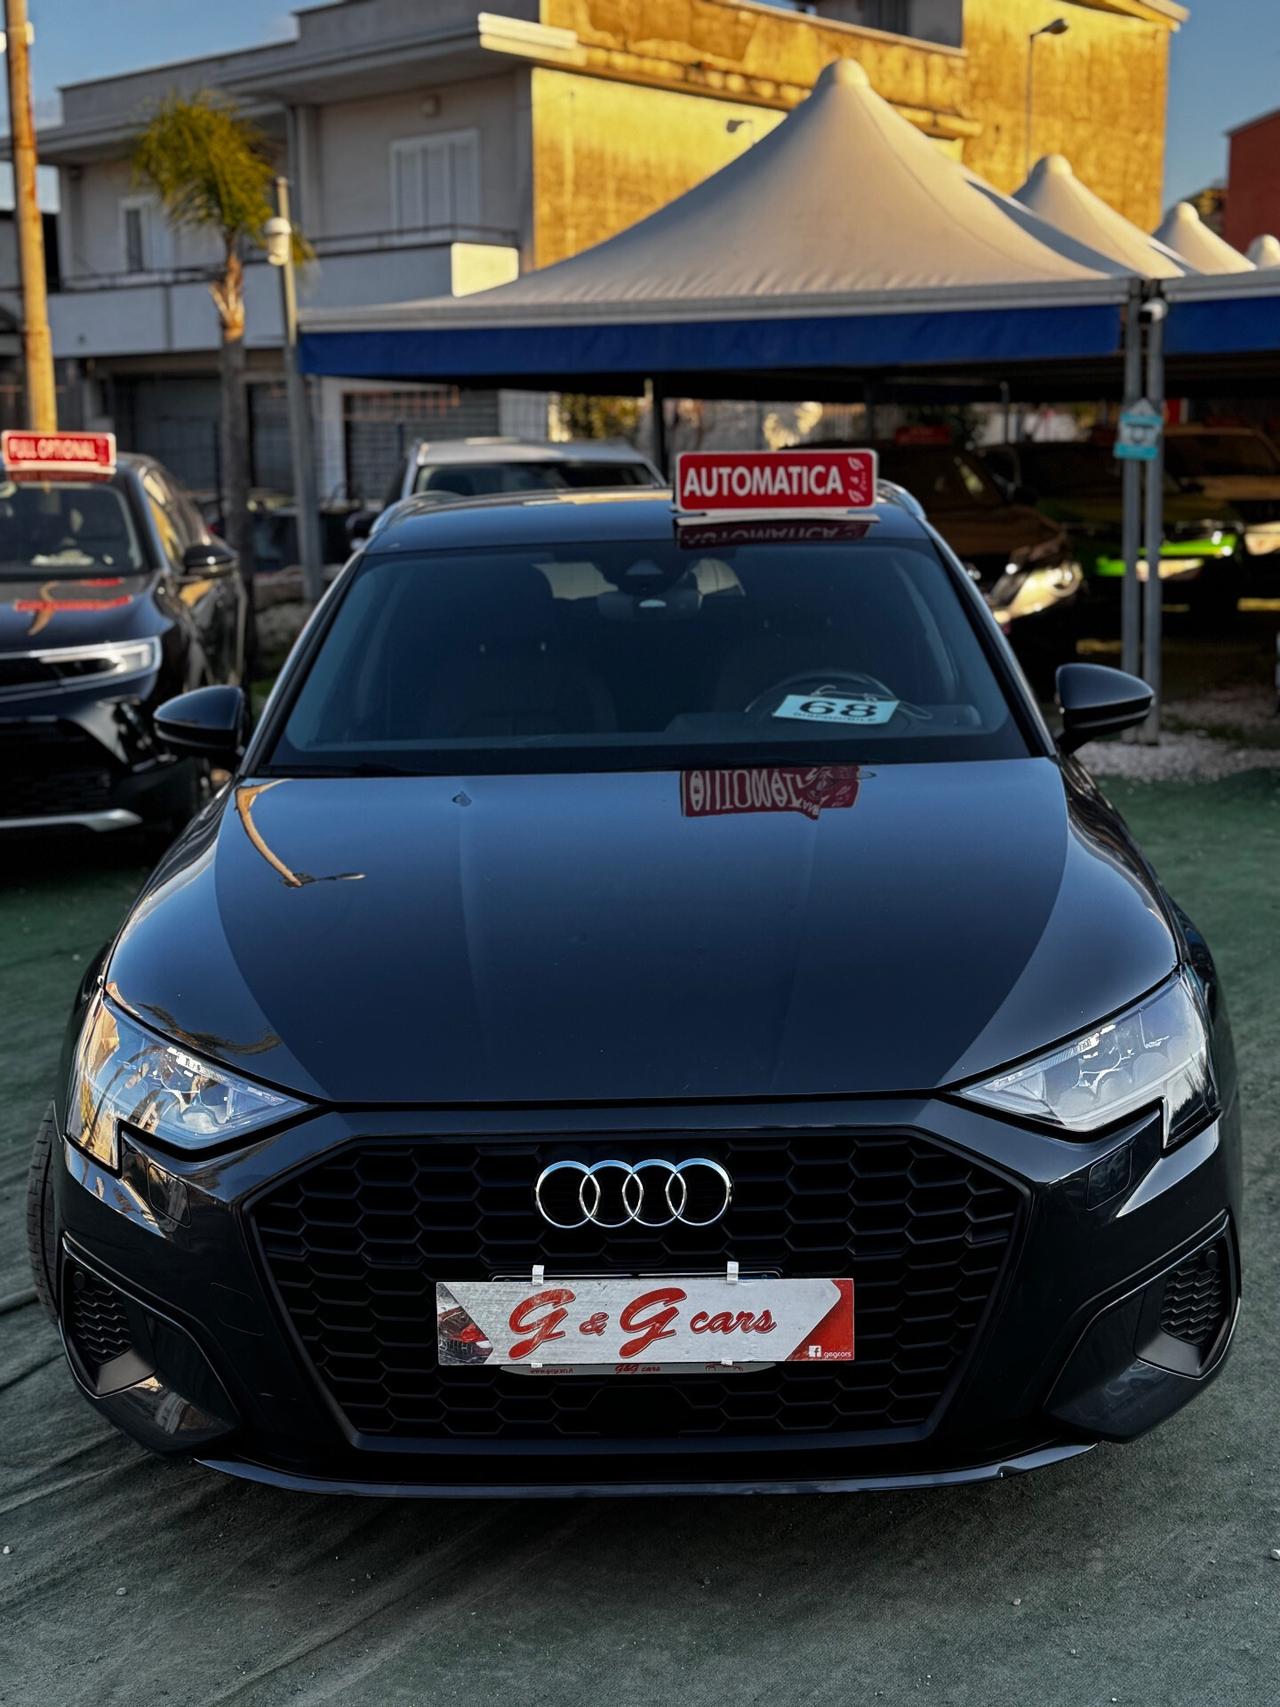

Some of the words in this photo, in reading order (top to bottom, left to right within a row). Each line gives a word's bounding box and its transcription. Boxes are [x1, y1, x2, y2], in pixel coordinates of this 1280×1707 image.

[683, 466, 843, 497] AUTOMATICA
[799, 700, 878, 718] 68
[508, 1288, 576, 1360] G
[579, 1311, 609, 1337] &
[619, 1287, 687, 1359] G
[689, 1309, 777, 1335] cars
